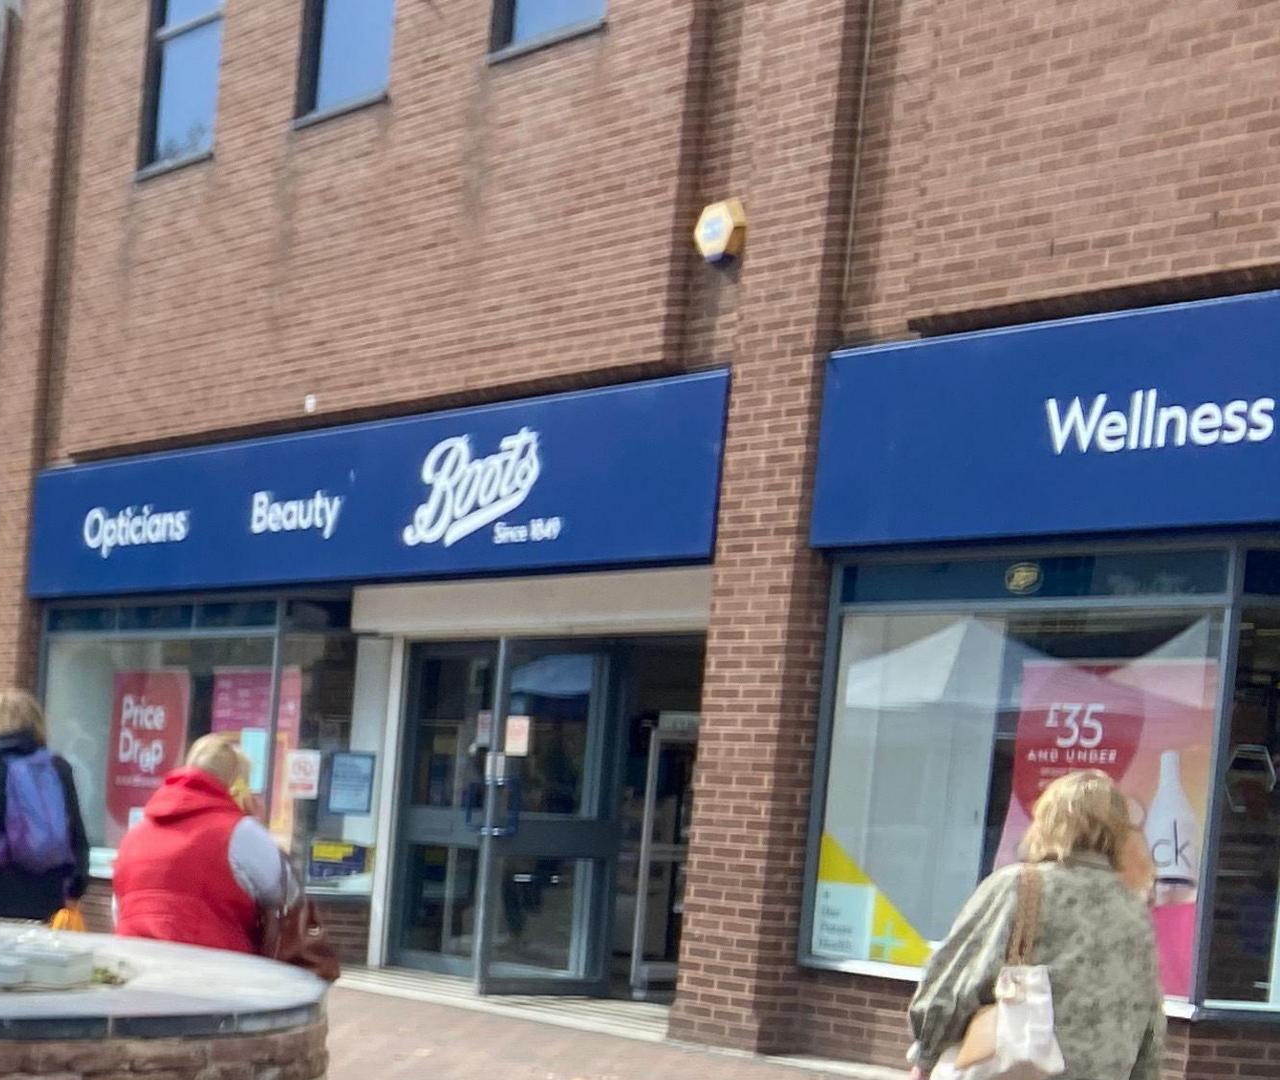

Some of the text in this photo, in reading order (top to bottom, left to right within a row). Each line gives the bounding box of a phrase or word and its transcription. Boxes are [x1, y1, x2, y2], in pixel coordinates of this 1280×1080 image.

[1045, 388, 1276, 456] Wellness
[403, 426, 540, 547] Boots
[84, 489, 343, 559] Opticians Beauty
[493, 521, 528, 545] Since
[122, 693, 166, 730] Price
[1044, 702, 1106, 749] £35
[1027, 749, 1118, 765] AND UNDER
[1152, 819, 1191, 869] ck
